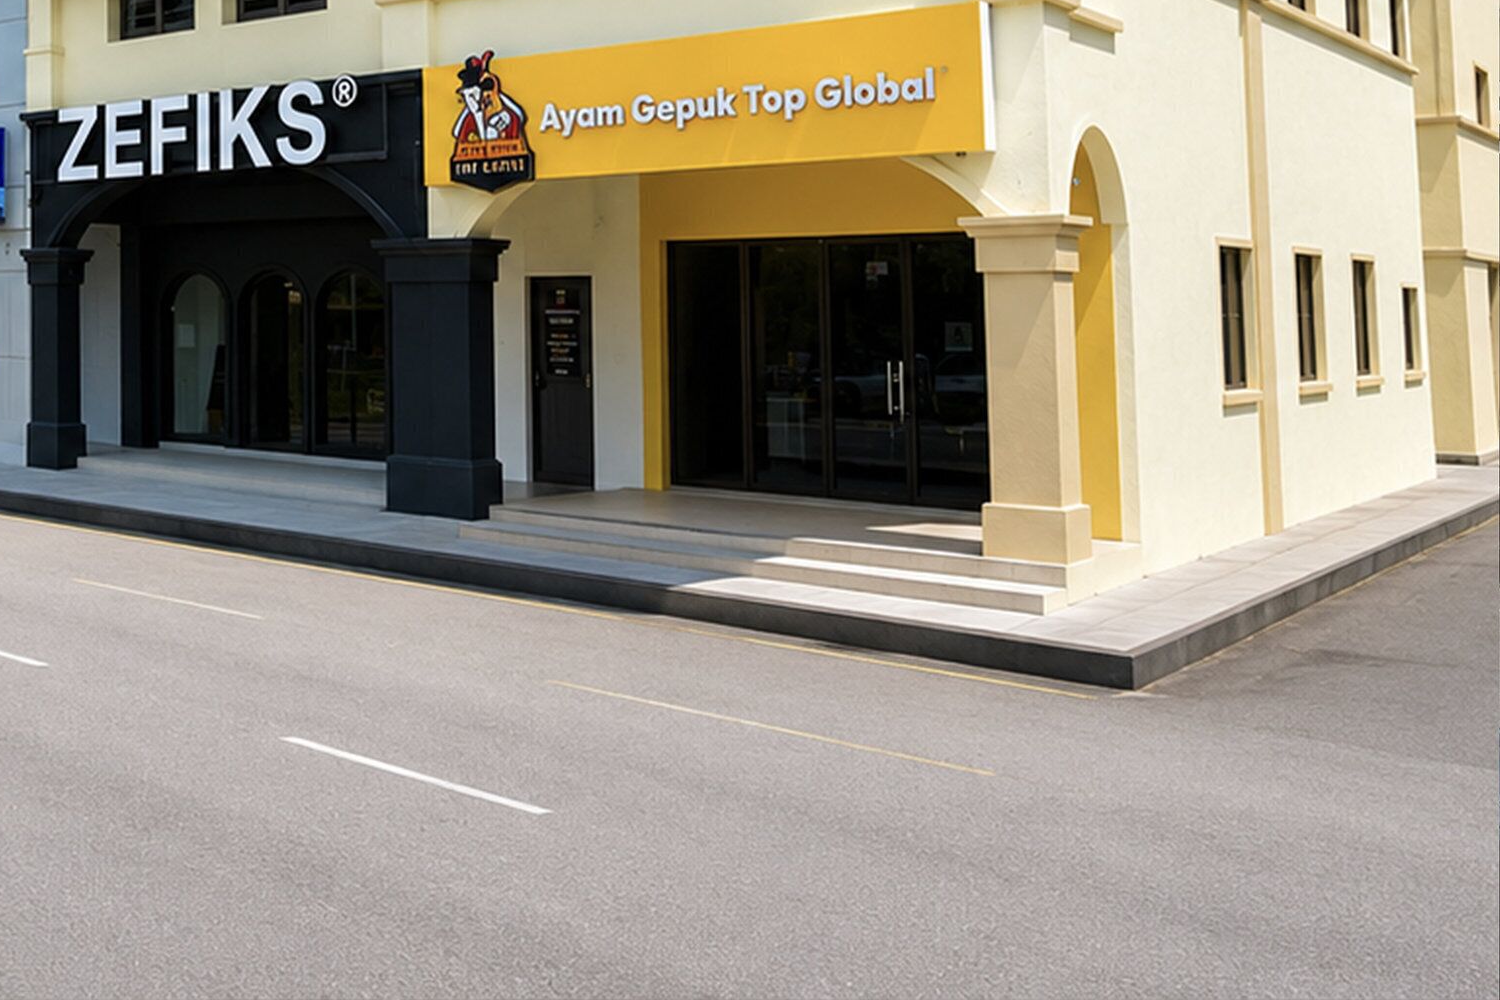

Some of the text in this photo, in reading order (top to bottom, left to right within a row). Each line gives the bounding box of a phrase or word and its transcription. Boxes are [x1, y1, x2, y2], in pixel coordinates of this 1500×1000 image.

[539, 66, 936, 138] Ayam Gepuk Top Global
